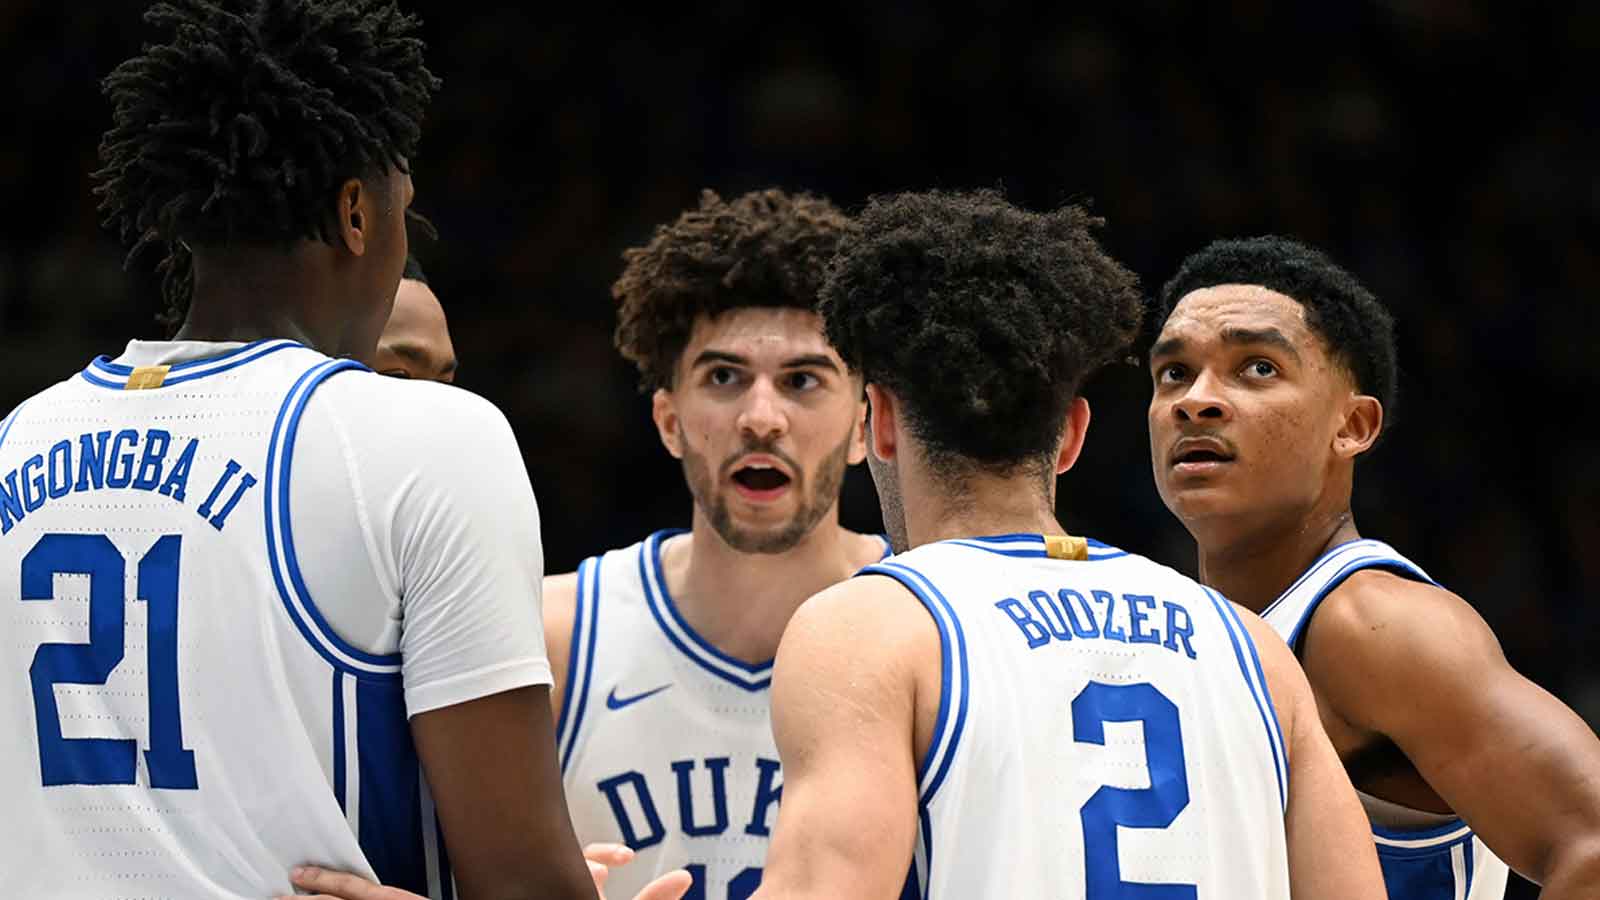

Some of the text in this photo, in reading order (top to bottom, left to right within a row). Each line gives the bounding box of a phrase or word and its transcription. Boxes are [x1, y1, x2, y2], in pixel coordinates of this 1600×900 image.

[0, 428, 258, 535] NGONGBA II
[20, 533, 199, 790] 21
[994, 588, 1197, 660] BOOZER
[597, 757, 784, 852] DUK
[1071, 680, 1198, 900] 2
